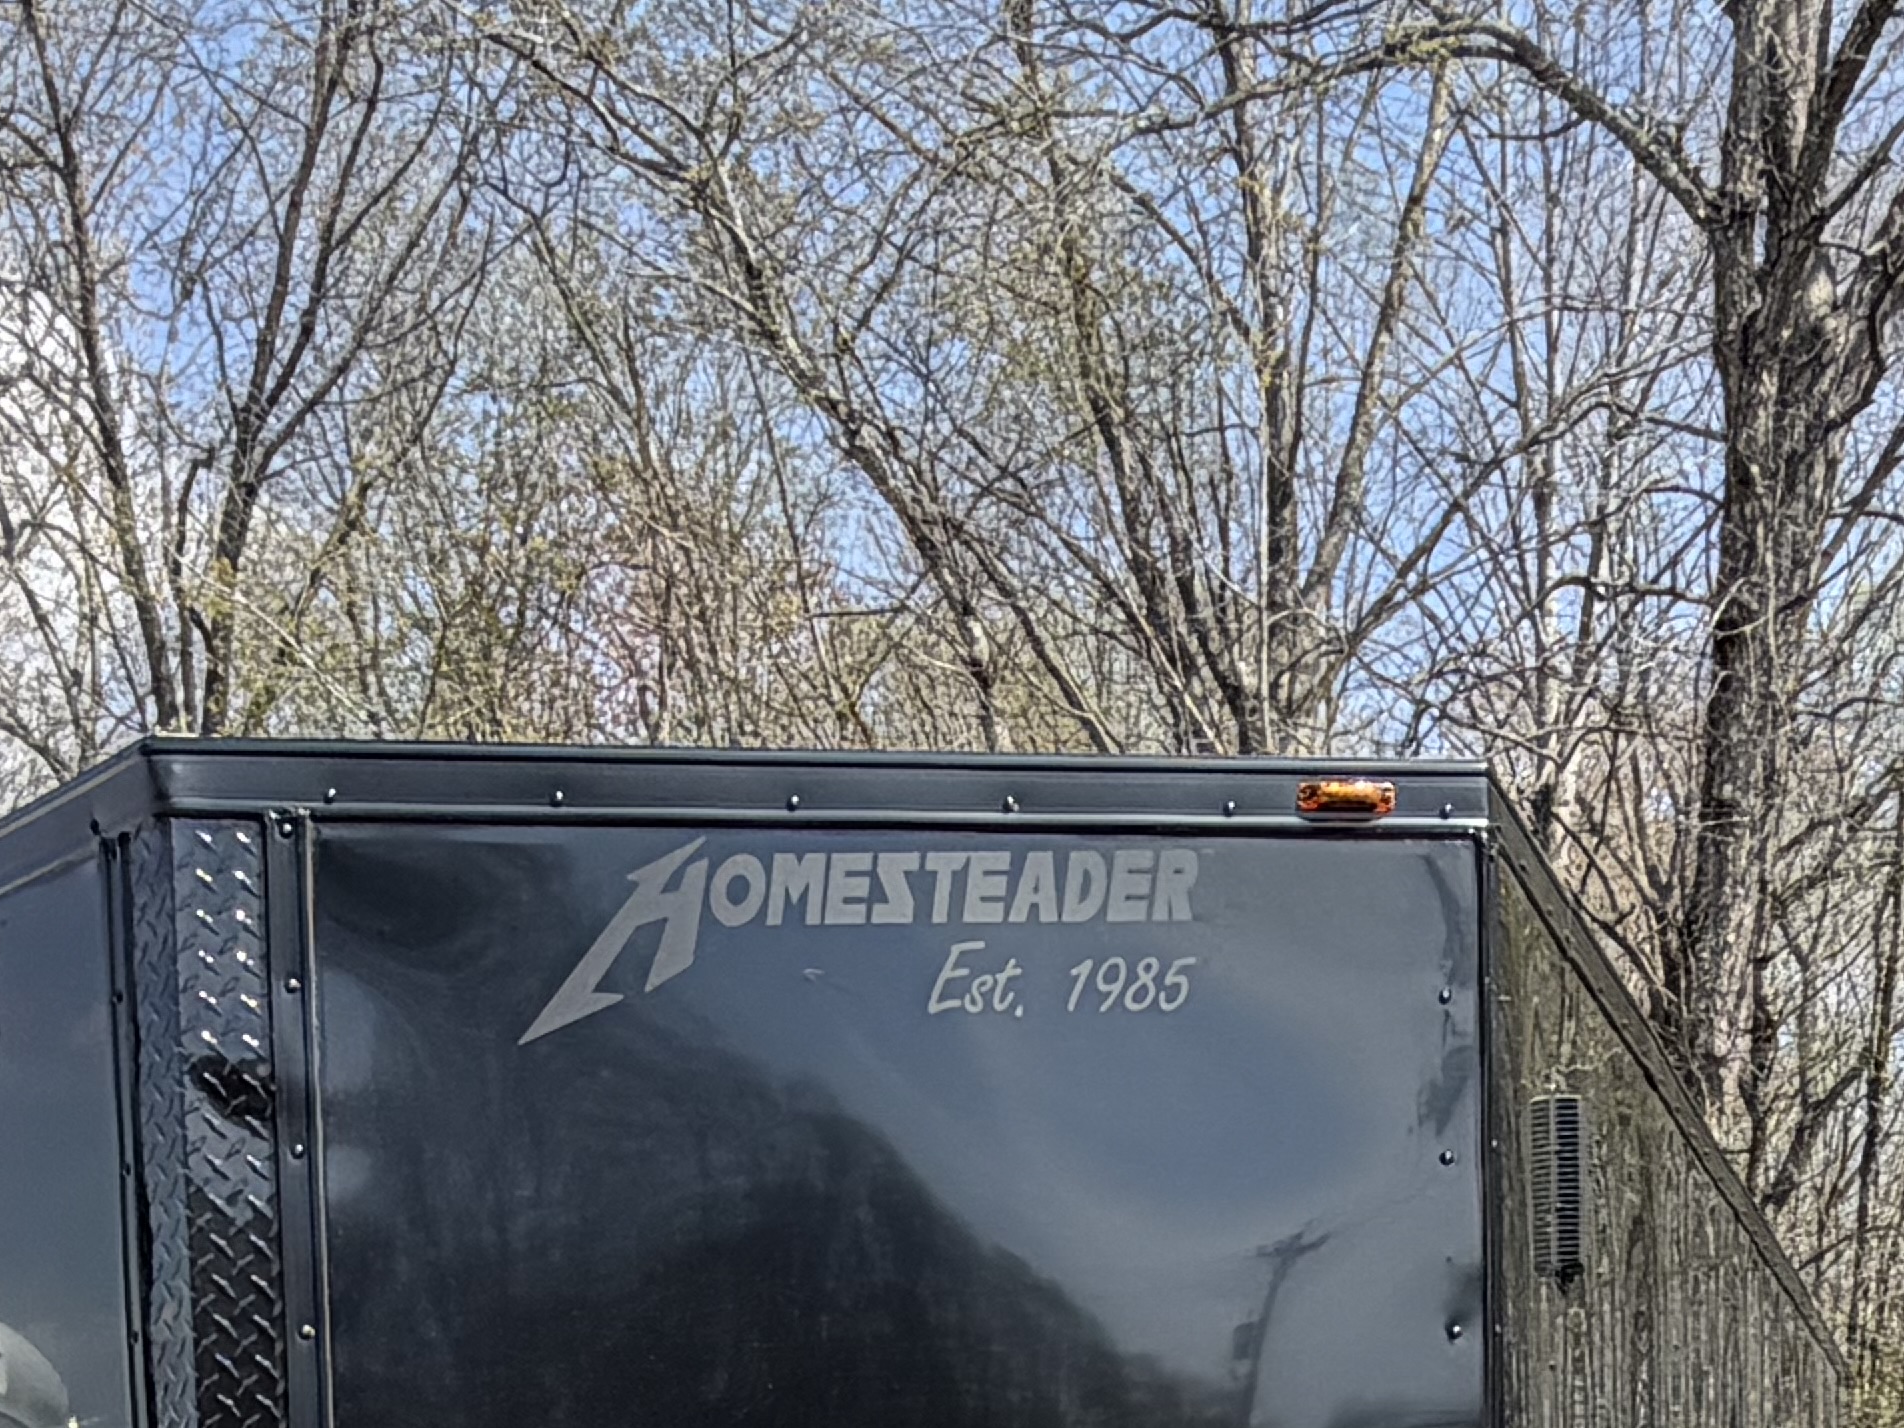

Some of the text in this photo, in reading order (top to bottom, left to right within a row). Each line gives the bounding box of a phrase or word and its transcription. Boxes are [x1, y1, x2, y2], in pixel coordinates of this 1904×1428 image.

[518, 835, 1200, 1046] HOMESTEADER
[927, 940, 1194, 1017] Est. 1985
